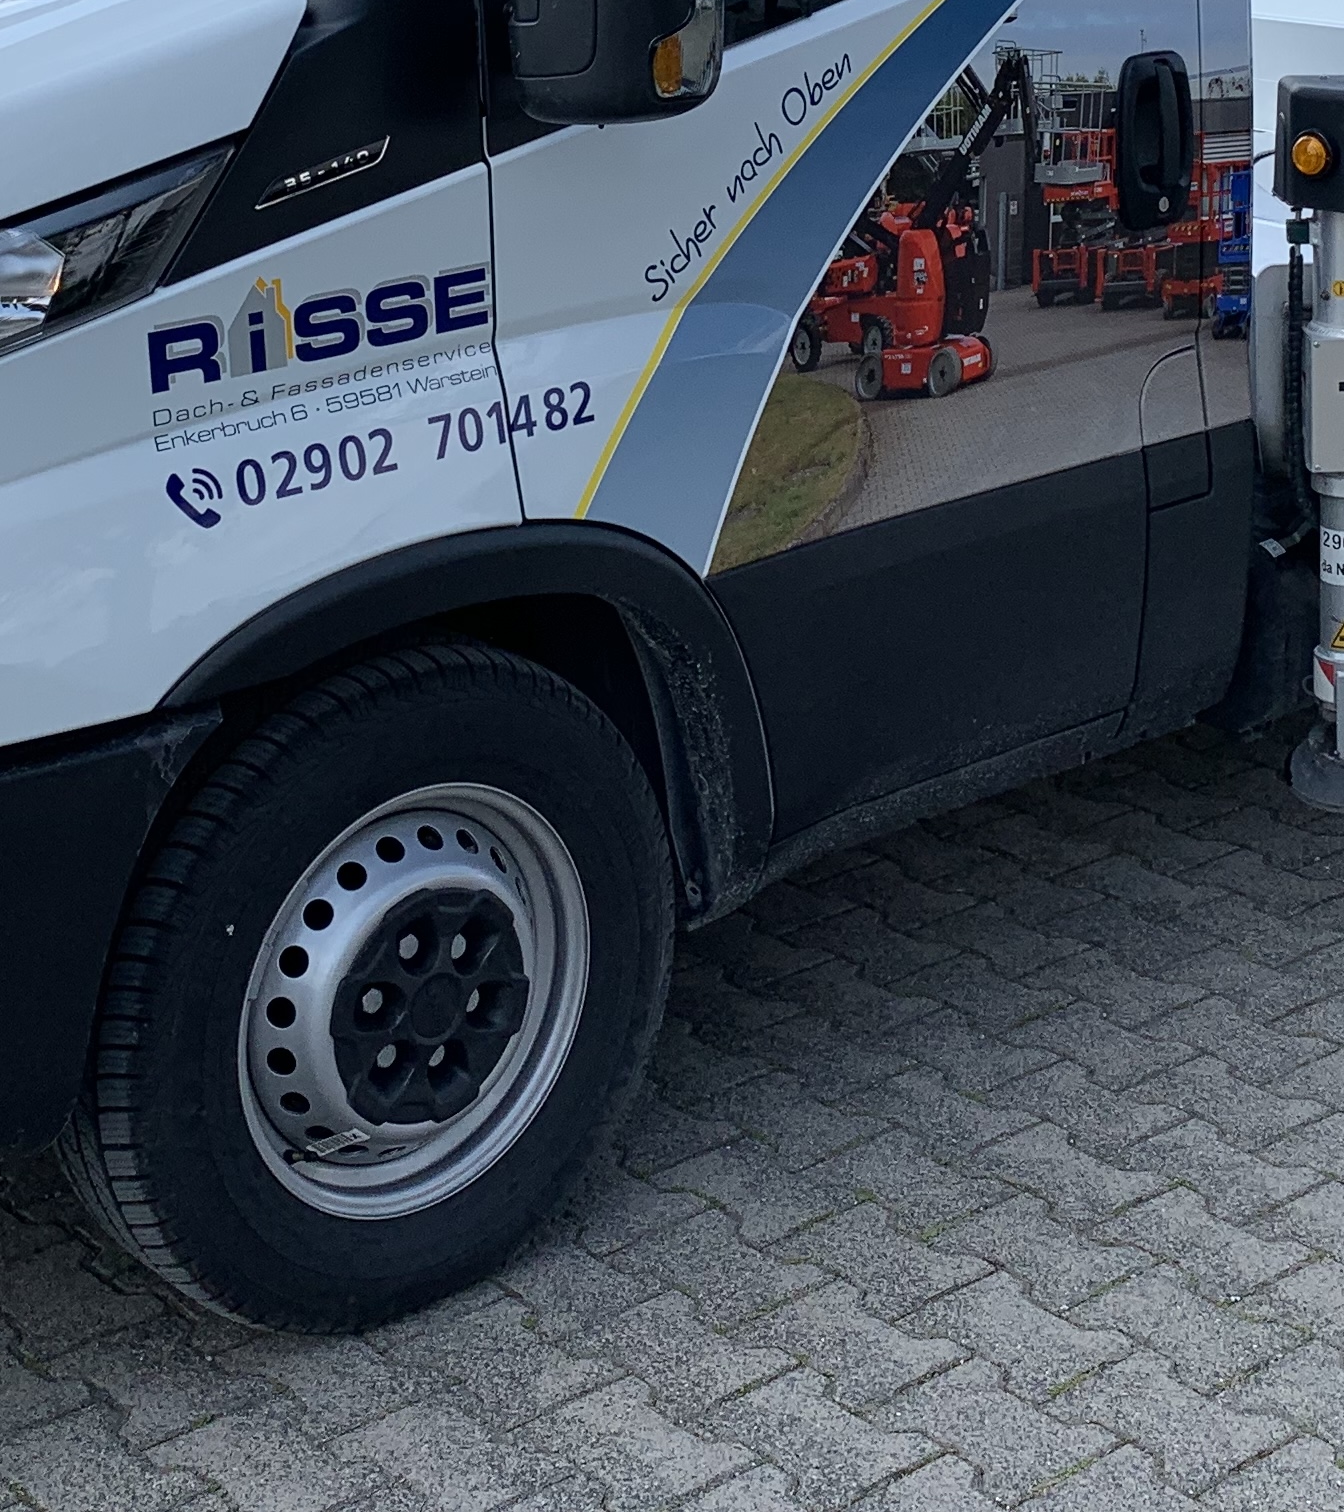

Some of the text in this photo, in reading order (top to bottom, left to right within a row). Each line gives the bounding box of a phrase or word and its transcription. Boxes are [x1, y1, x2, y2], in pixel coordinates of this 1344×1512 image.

[644, 52, 852, 302] Sicher nach Oben
[152, 340, 493, 427] Dach- & Fassadenservice
[154, 363, 500, 452] Enkerbruch 6 59581 Warstein
[235, 380, 596, 507] 02902 701482
